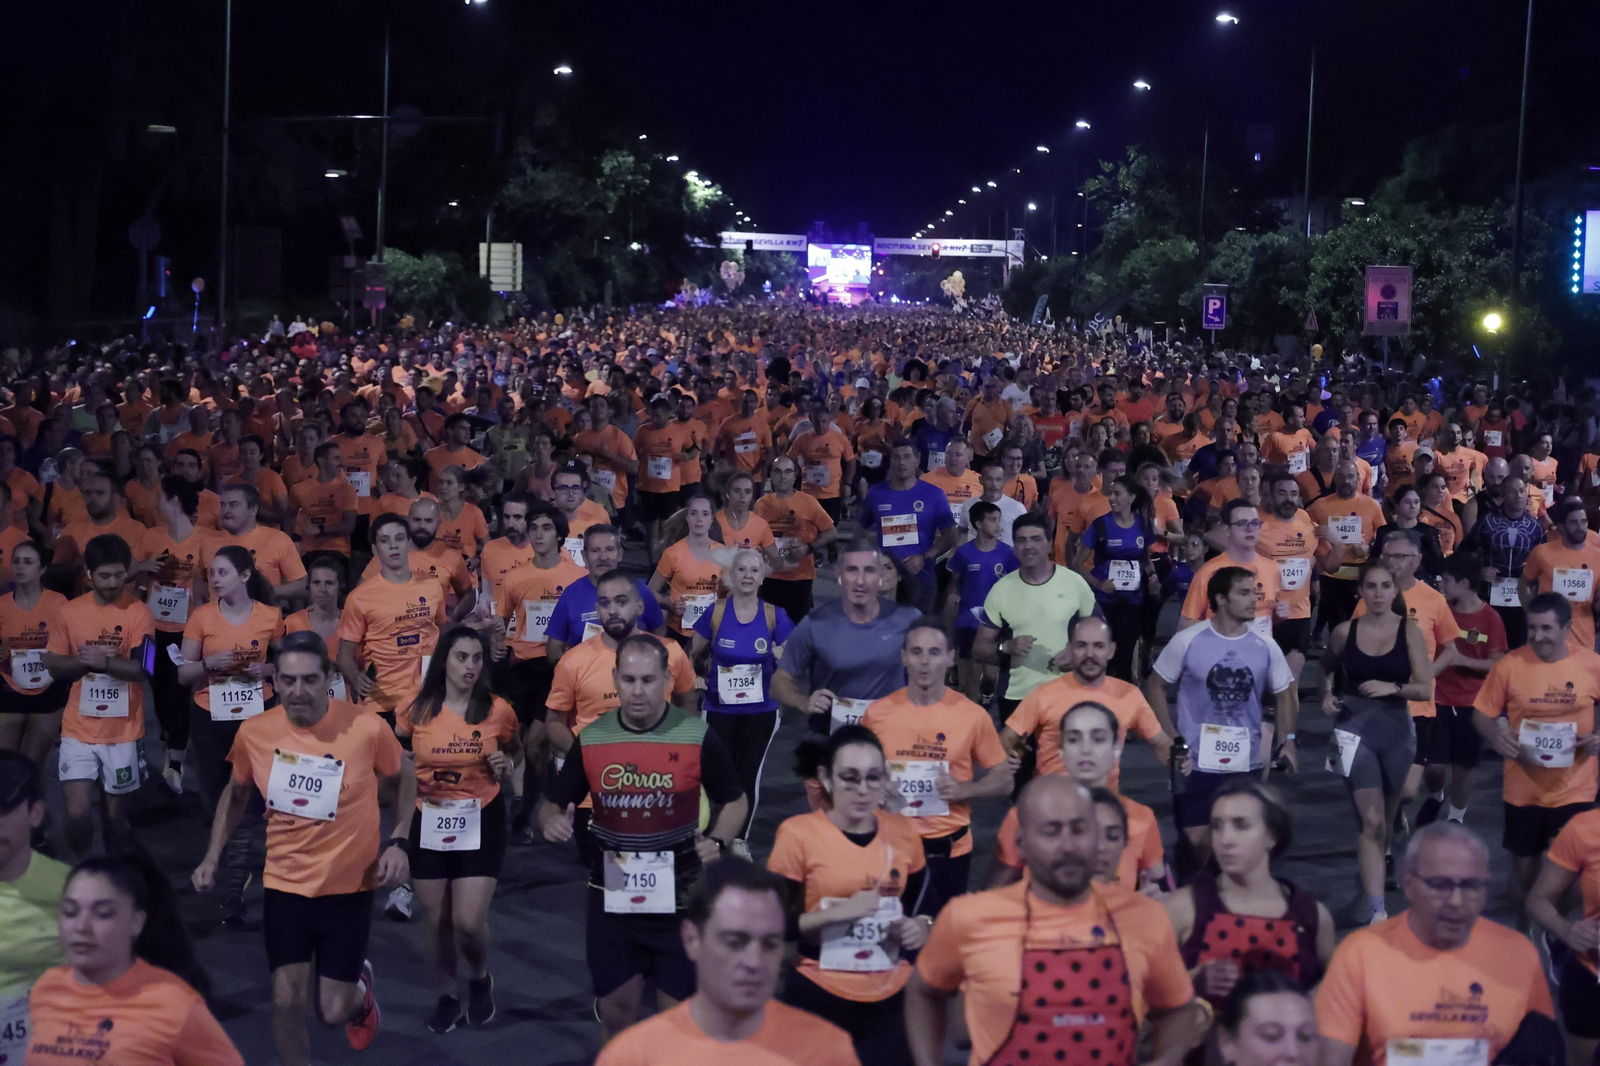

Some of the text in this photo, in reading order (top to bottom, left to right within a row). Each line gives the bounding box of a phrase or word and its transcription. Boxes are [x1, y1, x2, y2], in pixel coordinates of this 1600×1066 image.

[876, 242, 916, 250] NOCTURNA
[1208, 298, 1222, 315] P
[890, 524, 912, 534] 17382
[1336, 525, 1356, 533] 14820
[1117, 570, 1137, 579] 17392
[1281, 569, 1304, 577] 12411
[1563, 579, 1587, 588] 13568
[157, 597, 179, 609] 4497
[395, 612, 419, 623] SEVILLA
[727, 676, 756, 689] 17384
[88, 687, 120, 700] 11156
[221, 689, 255, 703] 11152
[1214, 740, 1236, 753] 8905
[1535, 736, 1563, 750] 9028
[431, 746, 483, 755] SEVILLA KH7
[895, 749, 928, 758] SEVILLA
[288, 773, 323, 793] 8709
[601, 763, 674, 790] Gorras
[902, 779, 934, 794] 2693
[598, 790, 676, 809] runners
[436, 816, 467, 830] 2879
[622, 872, 657, 888] 7150
